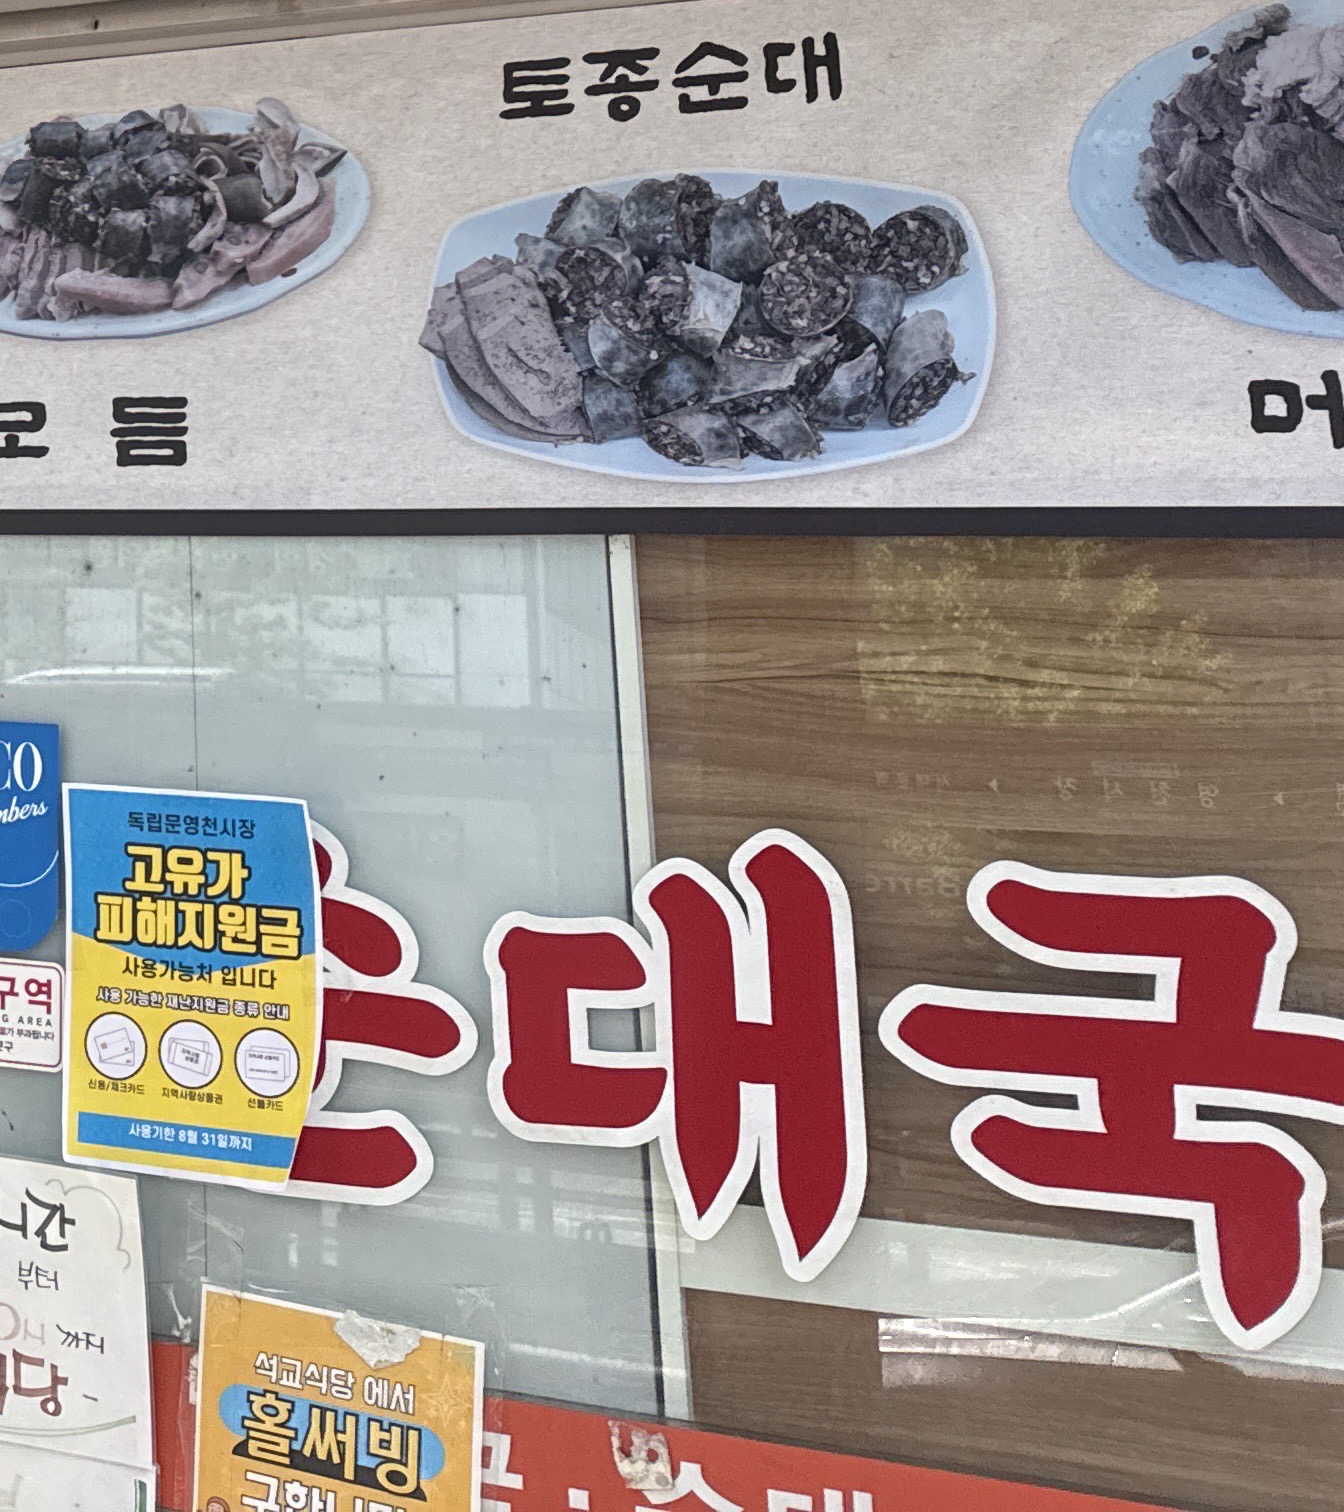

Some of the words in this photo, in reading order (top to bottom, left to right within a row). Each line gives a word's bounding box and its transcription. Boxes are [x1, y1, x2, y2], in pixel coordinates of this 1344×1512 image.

[498, 31, 845, 121] 토종순대
[127, 811, 255, 840] 독립문영천시장
[122, 842, 250, 901] 고유가
[94, 892, 303, 960] 피해지원금
[122, 956, 214, 985] 사용가능처
[221, 967, 278, 990] 입니다
[97, 987, 121, 1003] 사용
[125, 990, 162, 1009] 가능한
[166, 995, 231, 1016] 재난지원금
[232, 1000, 260, 1018] 종류
[262, 1002, 291, 1020] 안내
[17, 1015, 53, 1028] AREA
[161, 1087, 224, 1105] 지역사랑상품권
[128, 1122, 176, 1143] 사용기한
[178, 1129, 198, 1145] 8월
[201, 1132, 253, 1152] 31일까지
[18, 1260, 60, 1291] 부터
[56, 1324, 105, 1355] 까지
[253, 1351, 357, 1400] 석교식당
[362, 1375, 417, 1416] 에서
[242, 1386, 427, 1497] 홀써빙
